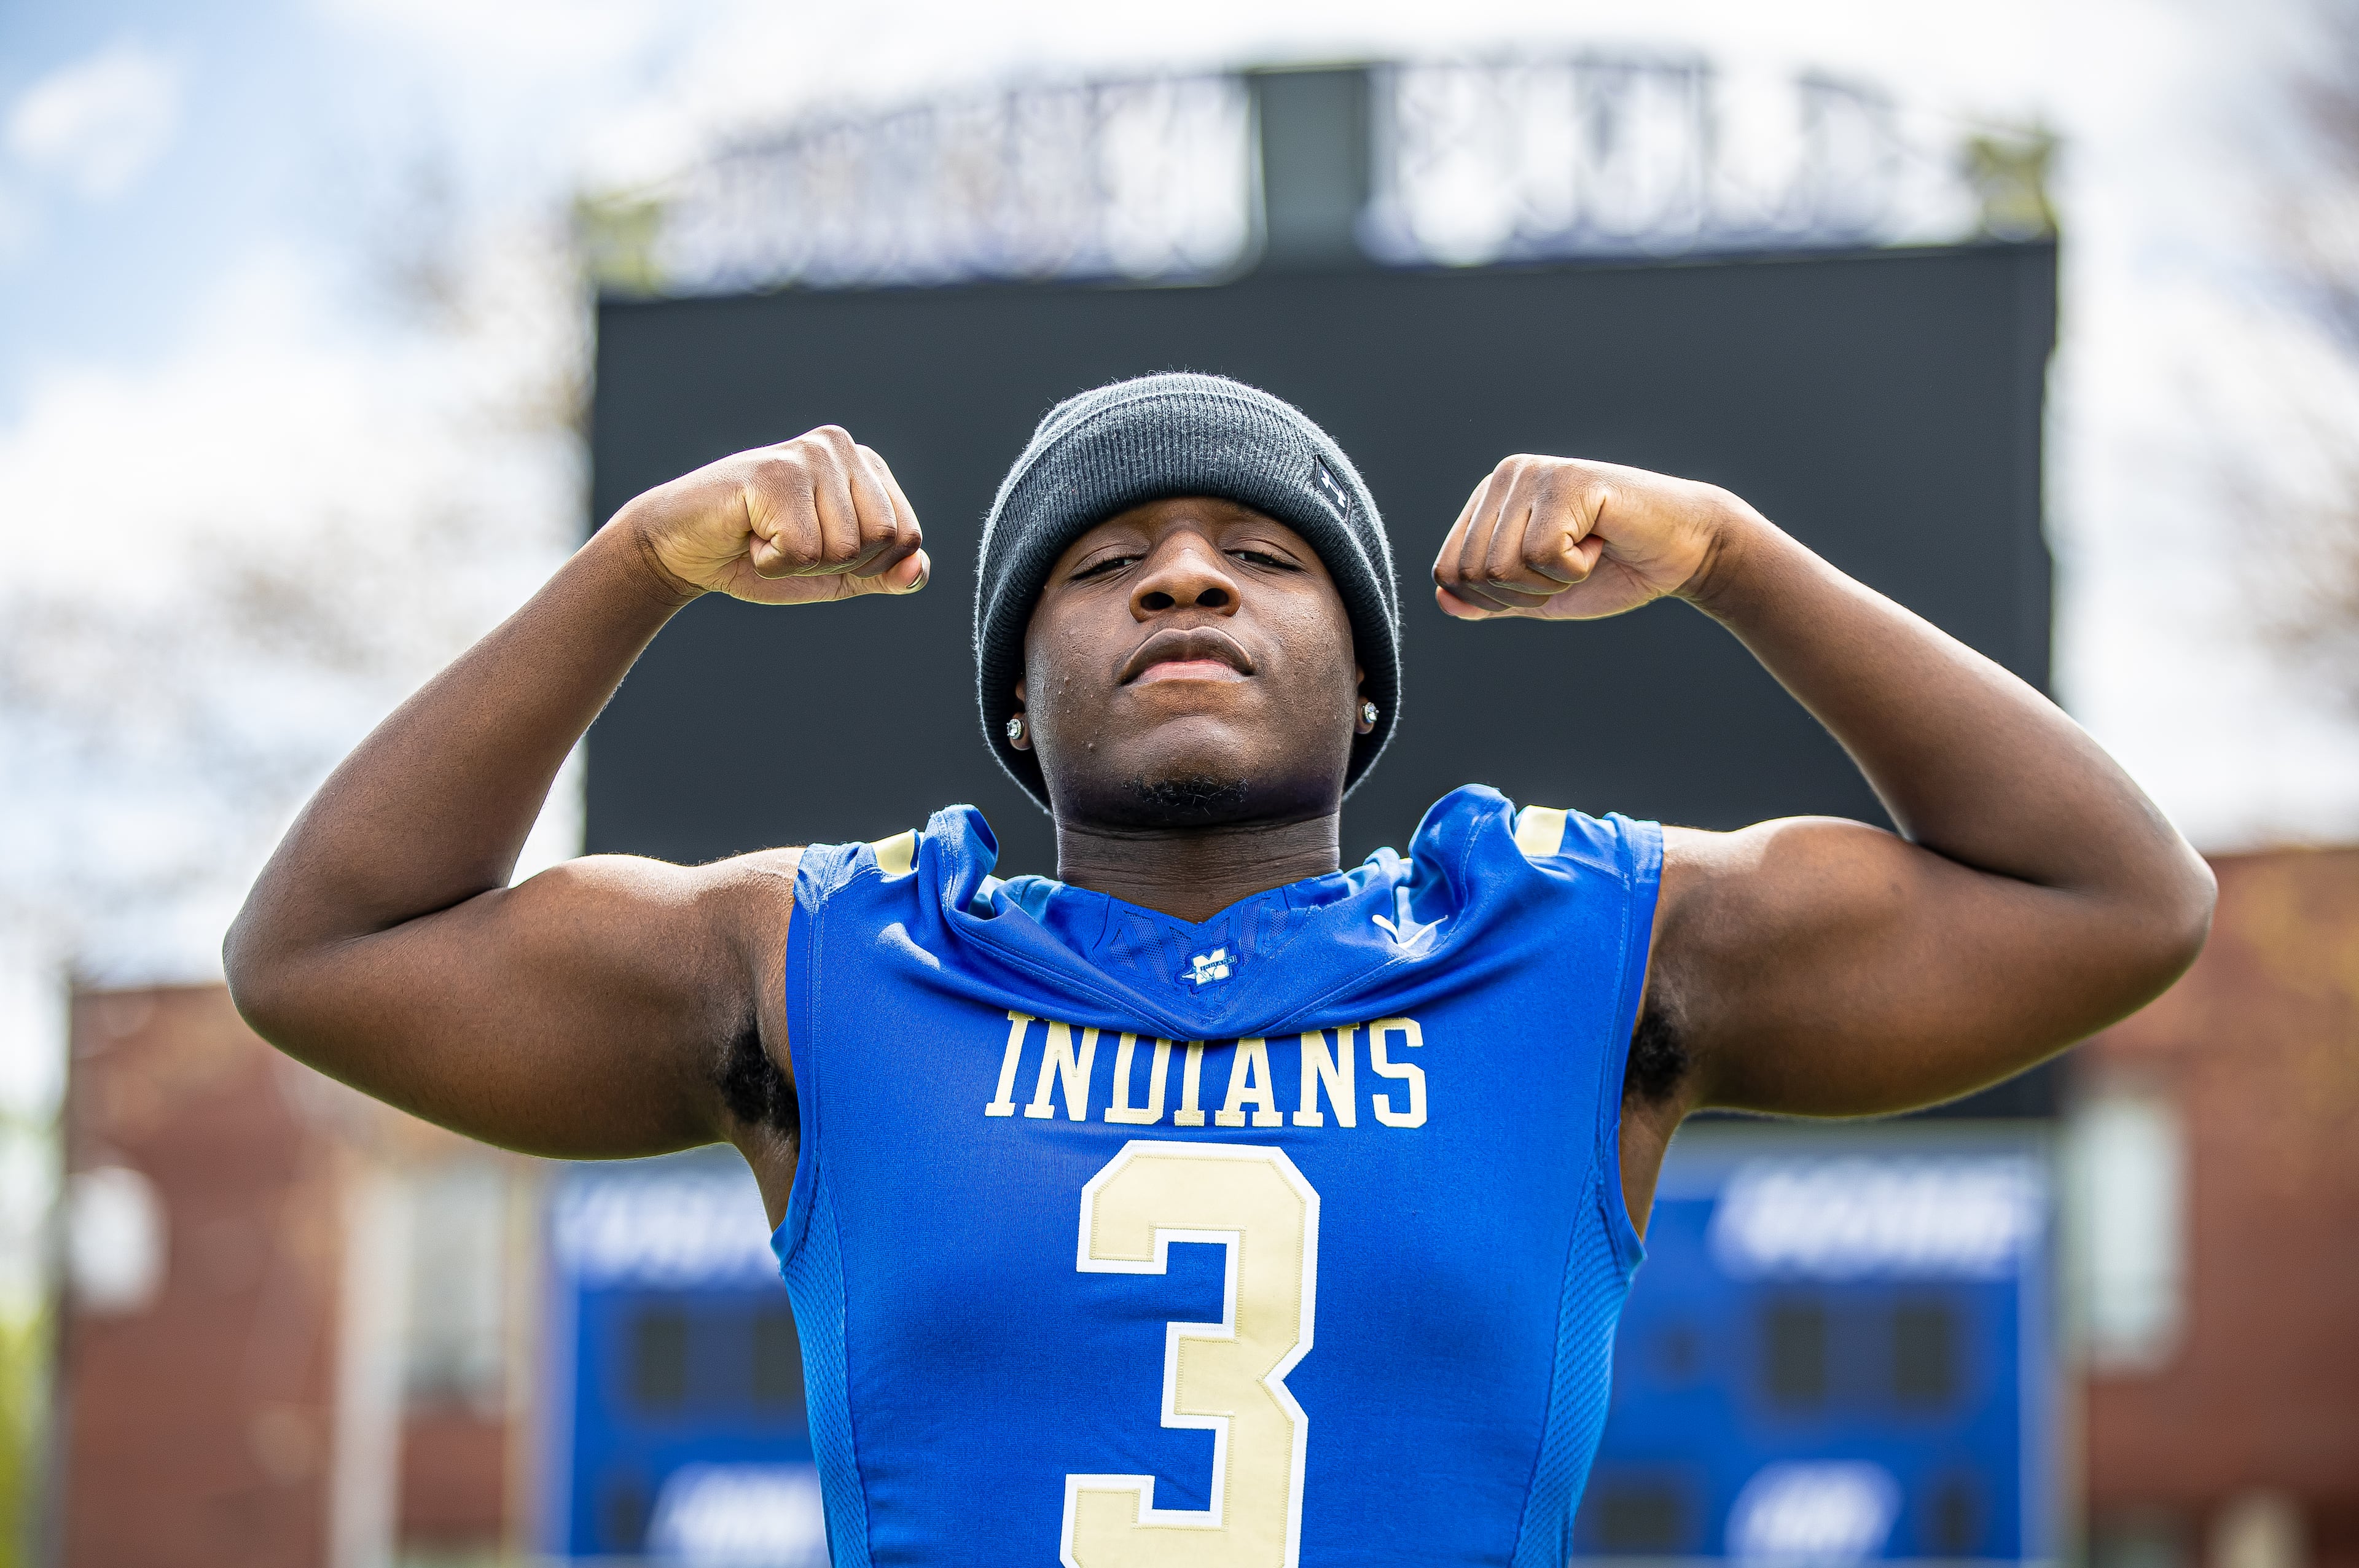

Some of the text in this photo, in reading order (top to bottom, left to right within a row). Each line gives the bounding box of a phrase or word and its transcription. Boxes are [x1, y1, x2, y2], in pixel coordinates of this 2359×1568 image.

[1192, 947, 1229, 985] M
[1201, 957, 1234, 970] INDIANS
[985, 1010, 1428, 1128] INDIANS
[1059, 1140, 1321, 1568] 3
